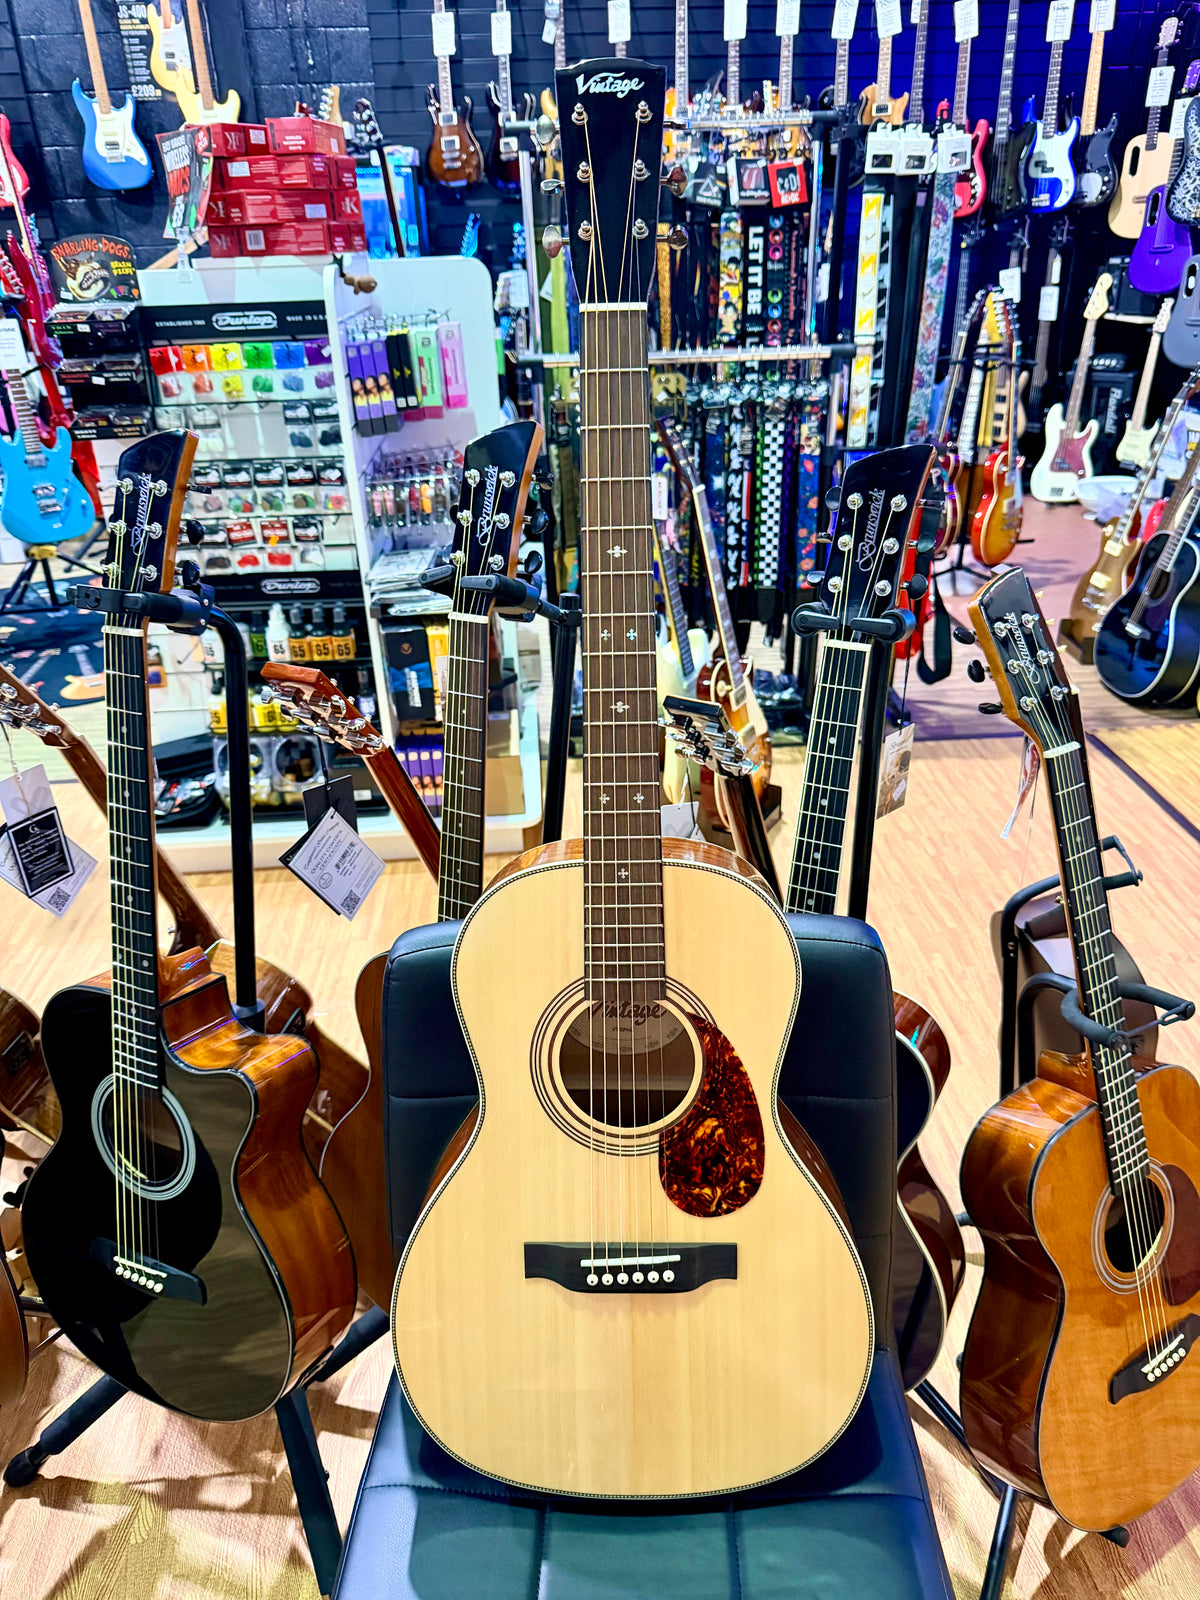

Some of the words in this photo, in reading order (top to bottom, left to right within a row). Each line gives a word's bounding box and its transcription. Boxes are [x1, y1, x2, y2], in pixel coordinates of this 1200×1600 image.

[117, 4, 147, 18] JS-400
[131, 84, 155, 97] £209
[575, 72, 645, 98] Vintage
[50, 238, 99, 260] SNARLING
[101, 237, 130, 258] DOGS
[748, 226, 764, 264] LET
[747, 264, 763, 288] IT
[746, 288, 763, 316] BE
[216, 314, 274, 328] Dunlop
[1104, 387, 1122, 434] Randall
[130, 472, 152, 556] Brunswick
[476, 464, 498, 546] Brunswick
[855, 488, 886, 572] Brunswick
[264, 580, 318, 592] Dunlop
[273, 644, 286, 655] 65
[291, 644, 306, 658] 65
[315, 643, 329, 656] 65
[336, 643, 351, 656] 65
[586, 1000, 668, 1026] Vintage
